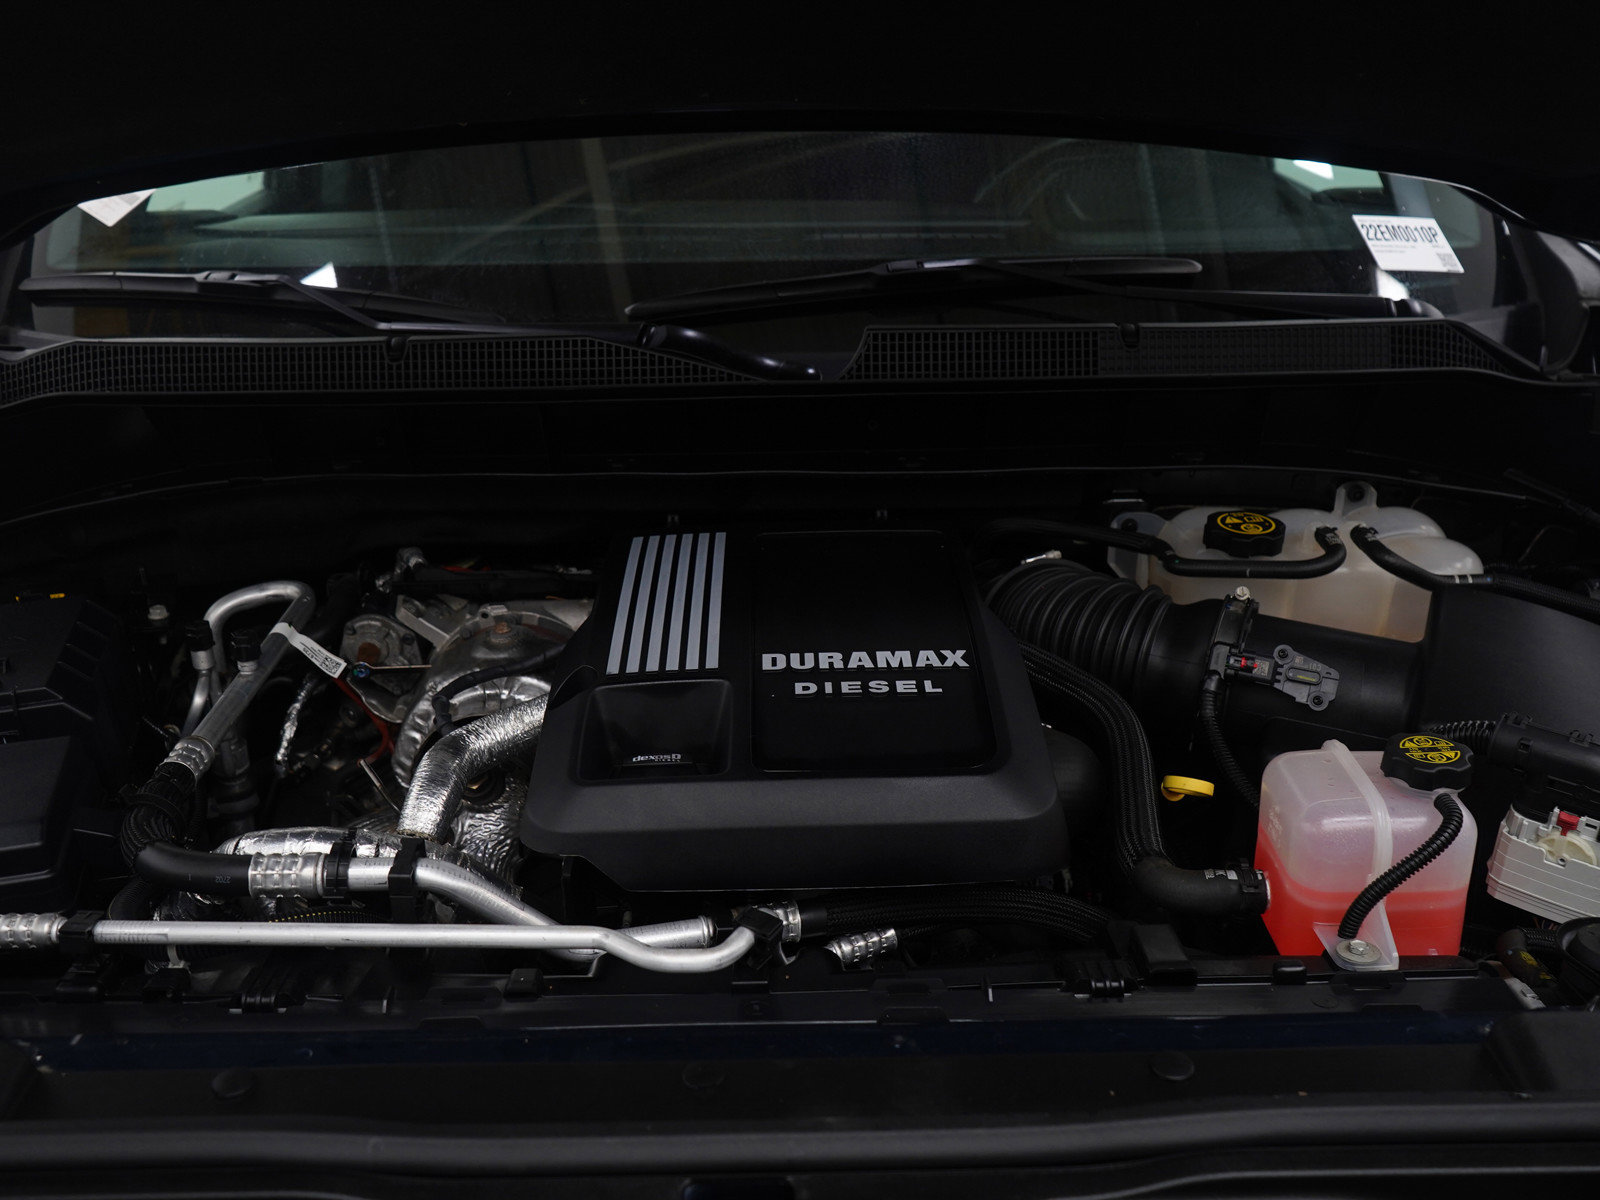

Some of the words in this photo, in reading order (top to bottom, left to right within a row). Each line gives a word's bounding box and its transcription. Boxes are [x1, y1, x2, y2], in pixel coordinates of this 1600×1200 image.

[1361, 224, 1438, 243] 22EM0010P
[761, 650, 970, 671] DURAMAX
[794, 679, 943, 695] DIESEL
